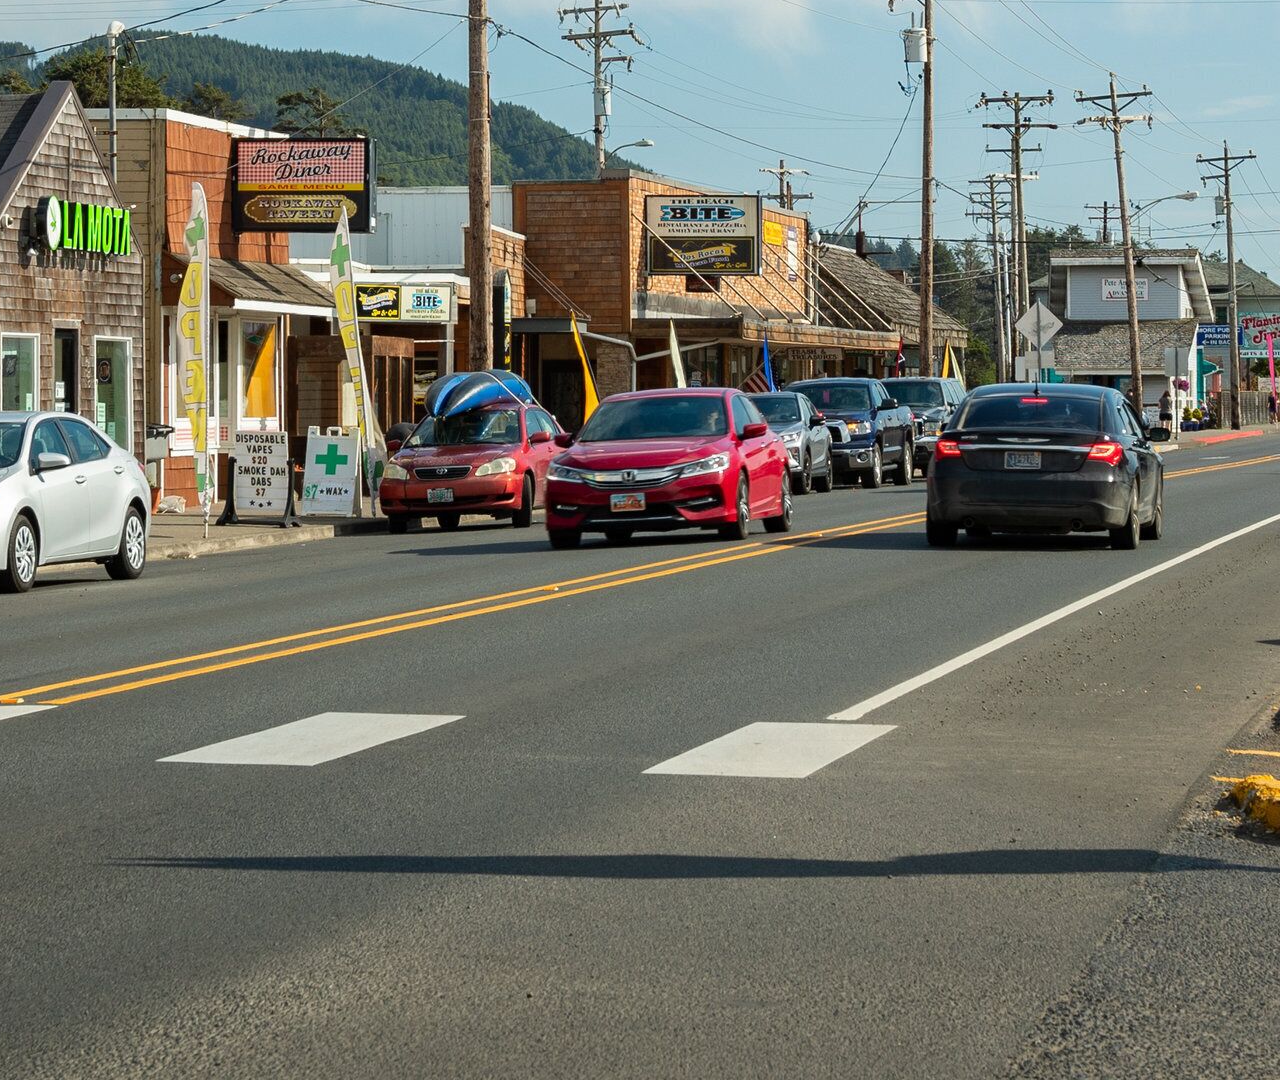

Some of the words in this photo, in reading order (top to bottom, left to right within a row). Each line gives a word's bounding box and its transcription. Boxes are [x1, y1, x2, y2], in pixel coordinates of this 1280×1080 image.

[251, 143, 352, 165] Rockaway
[274, 162, 332, 181] Diner
[258, 199, 343, 208] ROCKAWAY
[268, 209, 335, 219] TAVERN
[670, 207, 733, 220] BITE
[63, 199, 84, 250] LA
[87, 203, 131, 256] MOTA
[698, 249, 725, 258] Rocas
[415, 296, 438, 307] BITE
[235, 433, 286, 445] DISPOSABLE
[246, 445, 273, 454] VAPES
[251, 456, 268, 465] $20
[238, 465, 266, 476] SMOKE
[270, 467, 286, 476] DAH
[250, 477, 272, 487] DABS
[255, 488, 266, 497] $7
[304, 484, 319, 500] $7
[325, 487, 344, 496] WAX
